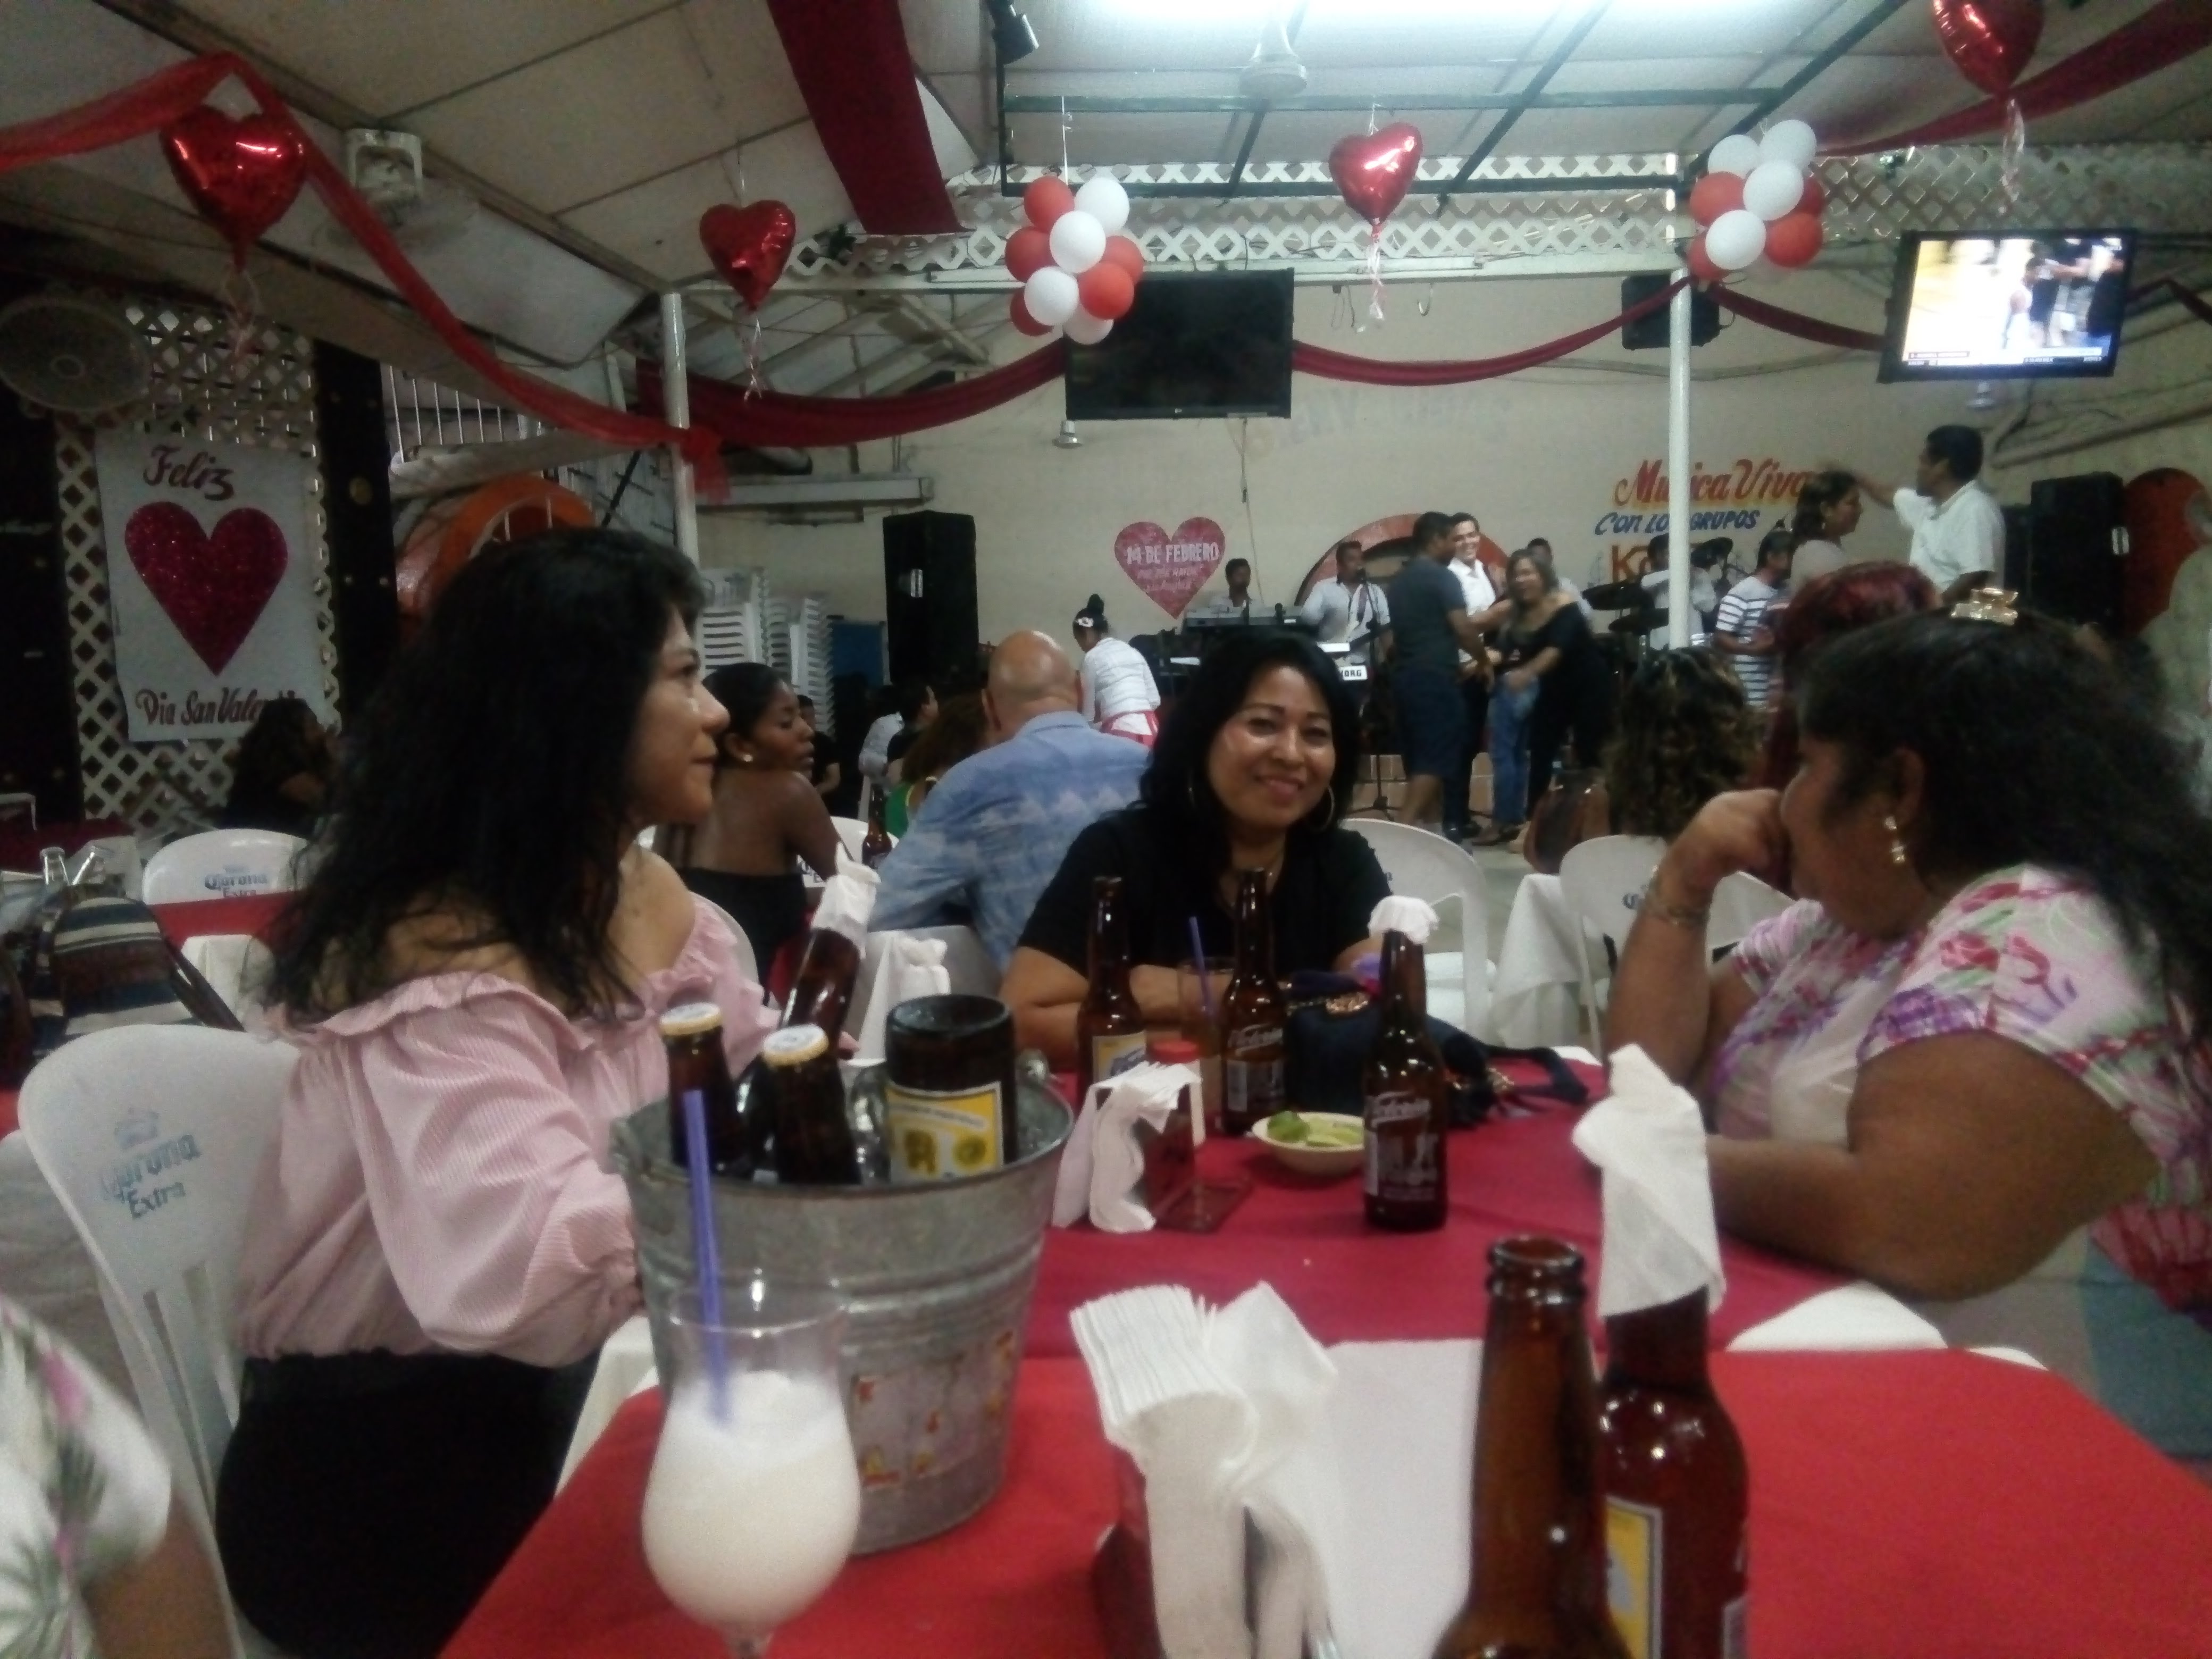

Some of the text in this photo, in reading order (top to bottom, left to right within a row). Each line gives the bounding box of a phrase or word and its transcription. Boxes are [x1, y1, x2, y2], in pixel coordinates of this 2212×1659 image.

[143, 443, 234, 500] Feliz
[1127, 541, 1220, 565] 14 DE FEBRERO
[204, 873, 268, 891] Corona
[128, 1182, 187, 1219] Extra
